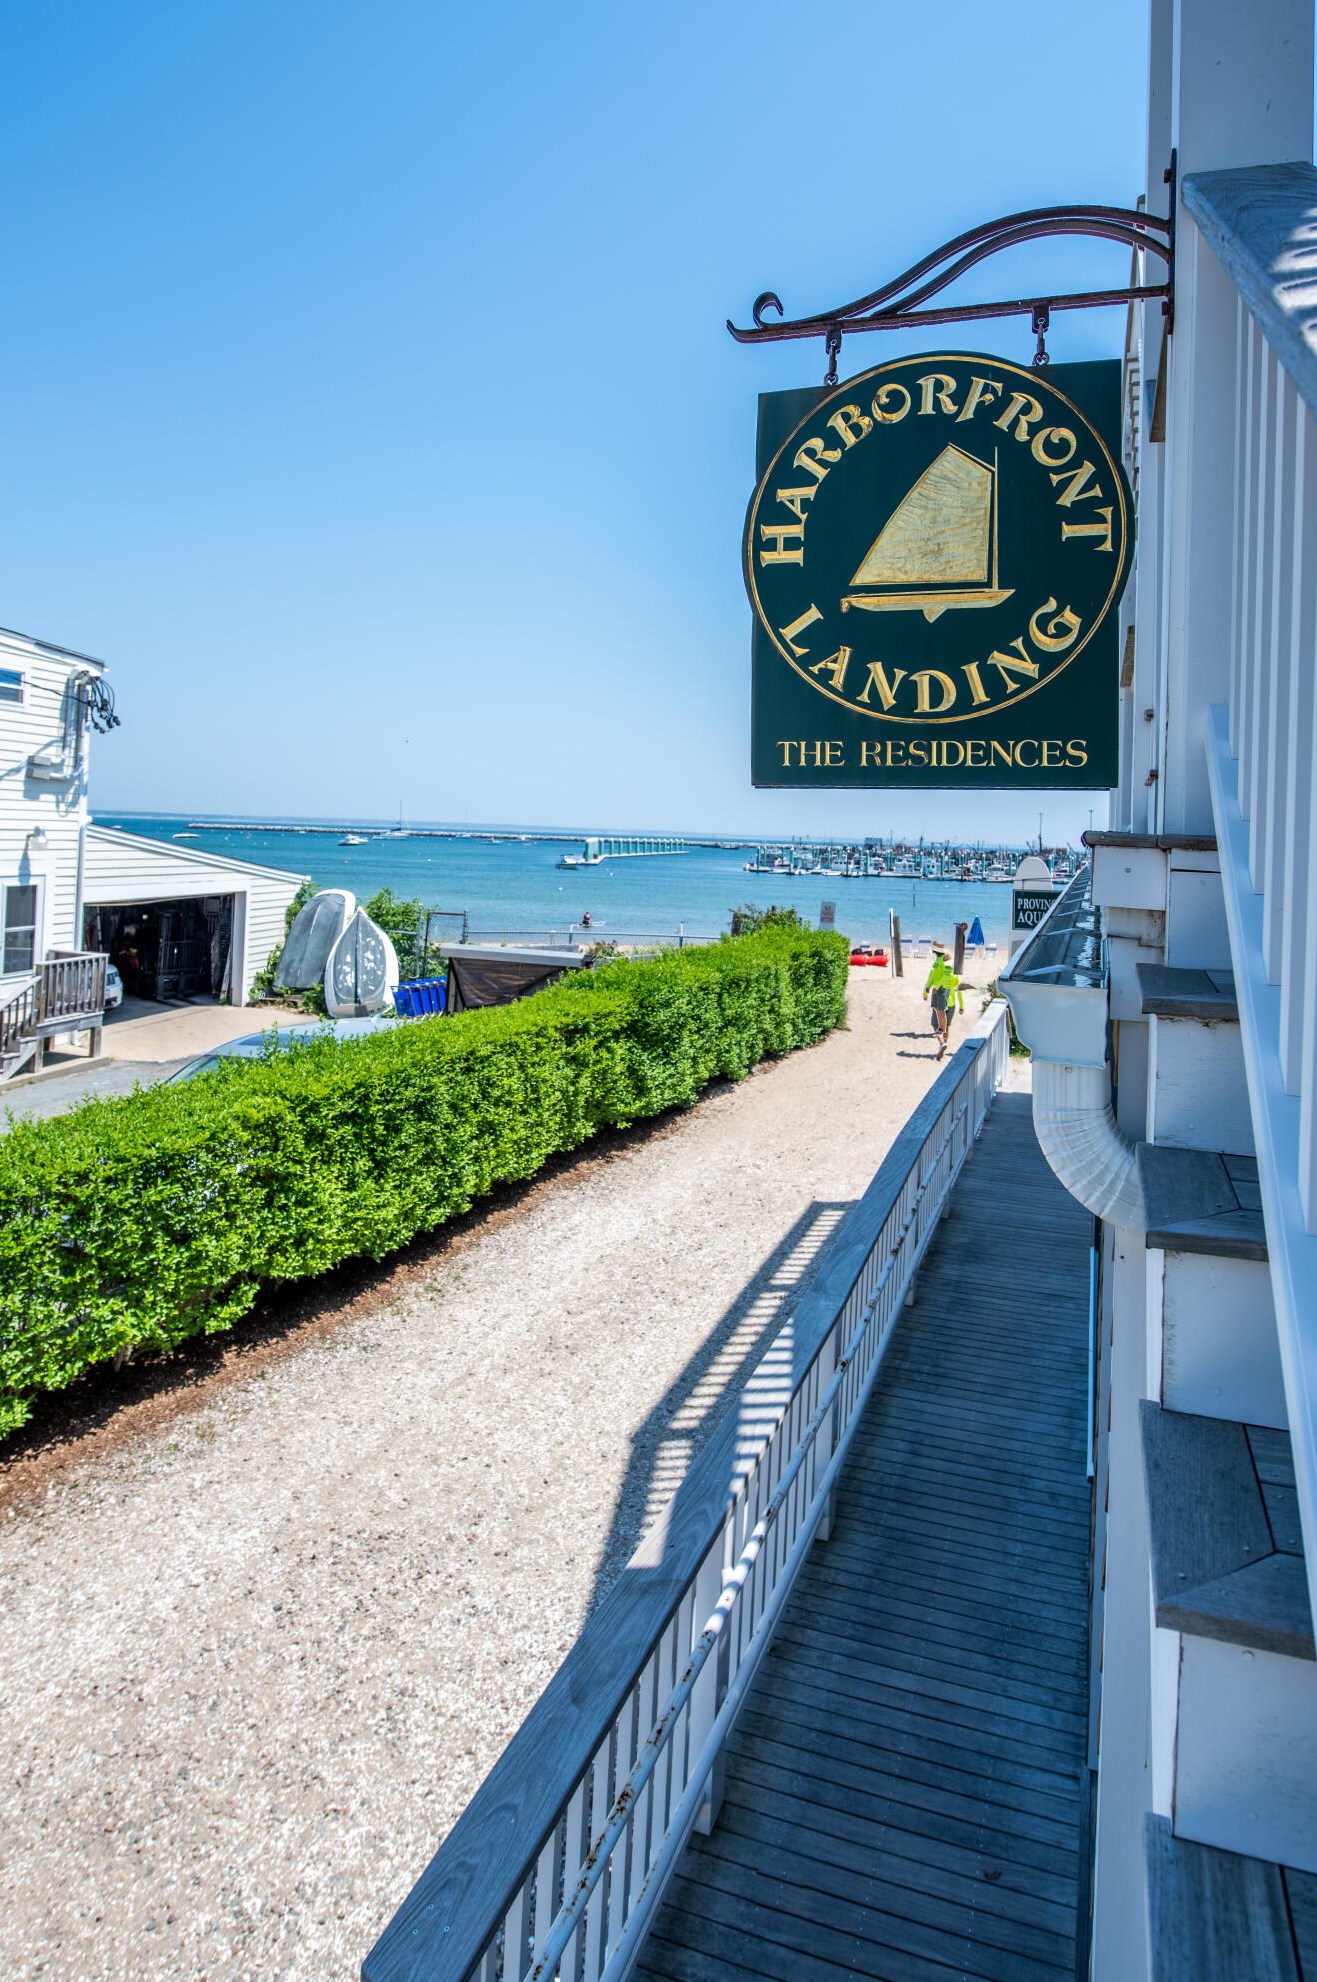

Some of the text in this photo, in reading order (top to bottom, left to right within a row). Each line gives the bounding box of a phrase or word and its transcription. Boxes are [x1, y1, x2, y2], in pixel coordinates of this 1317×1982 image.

[759, 373, 1114, 568] HARBORFRONT
[779, 595, 1083, 714] LANDING
[776, 739, 1088, 768] THE RESIDENCES
